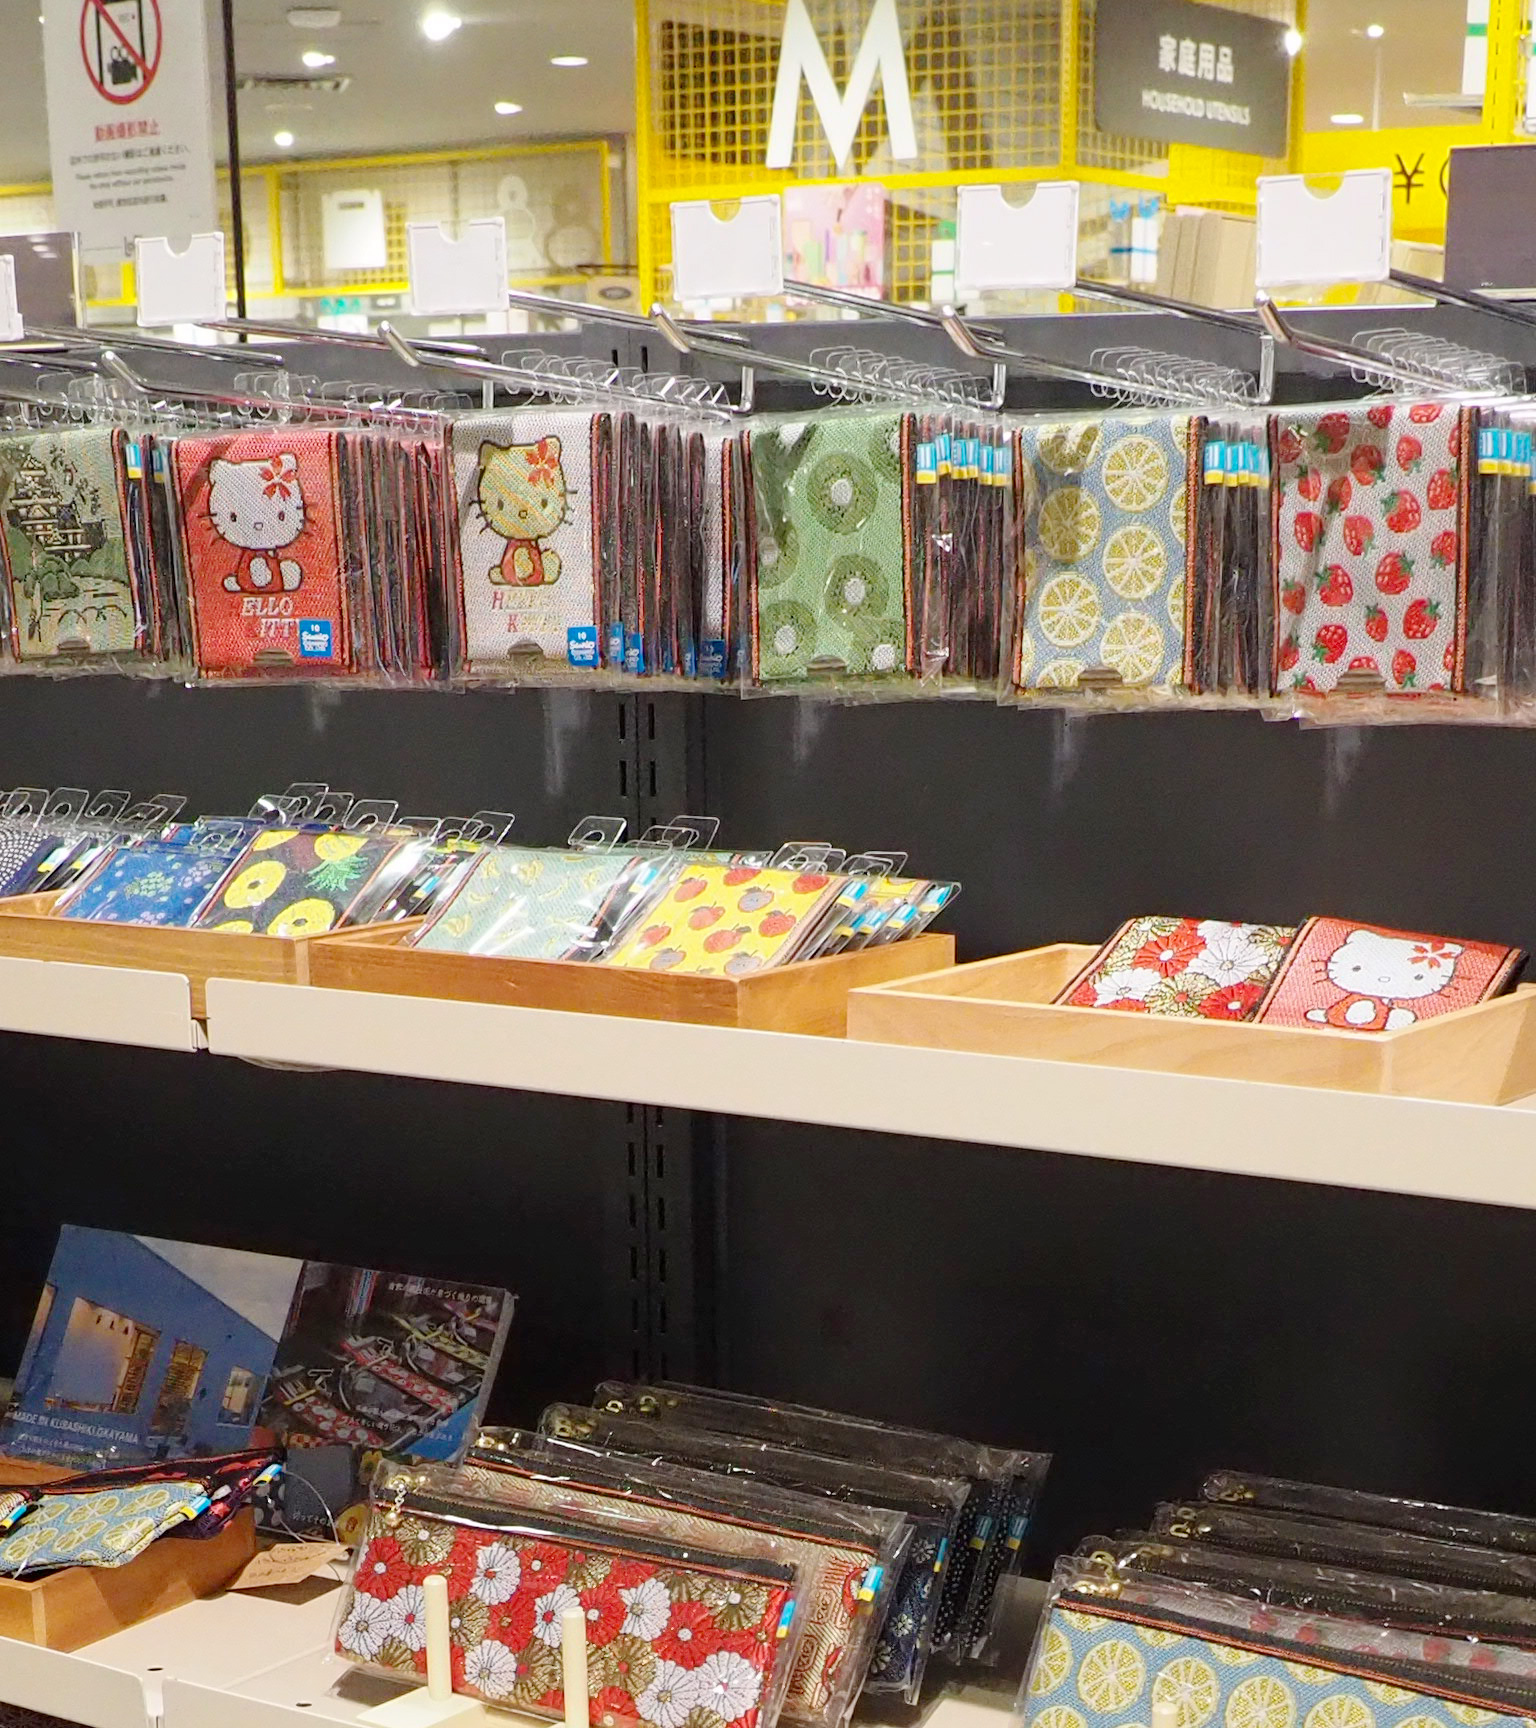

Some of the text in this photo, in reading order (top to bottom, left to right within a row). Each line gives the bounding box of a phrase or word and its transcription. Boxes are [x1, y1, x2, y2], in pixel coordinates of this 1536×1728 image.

[766, 0, 918, 172] M
[1158, 34, 1235, 85] 家庭用品
